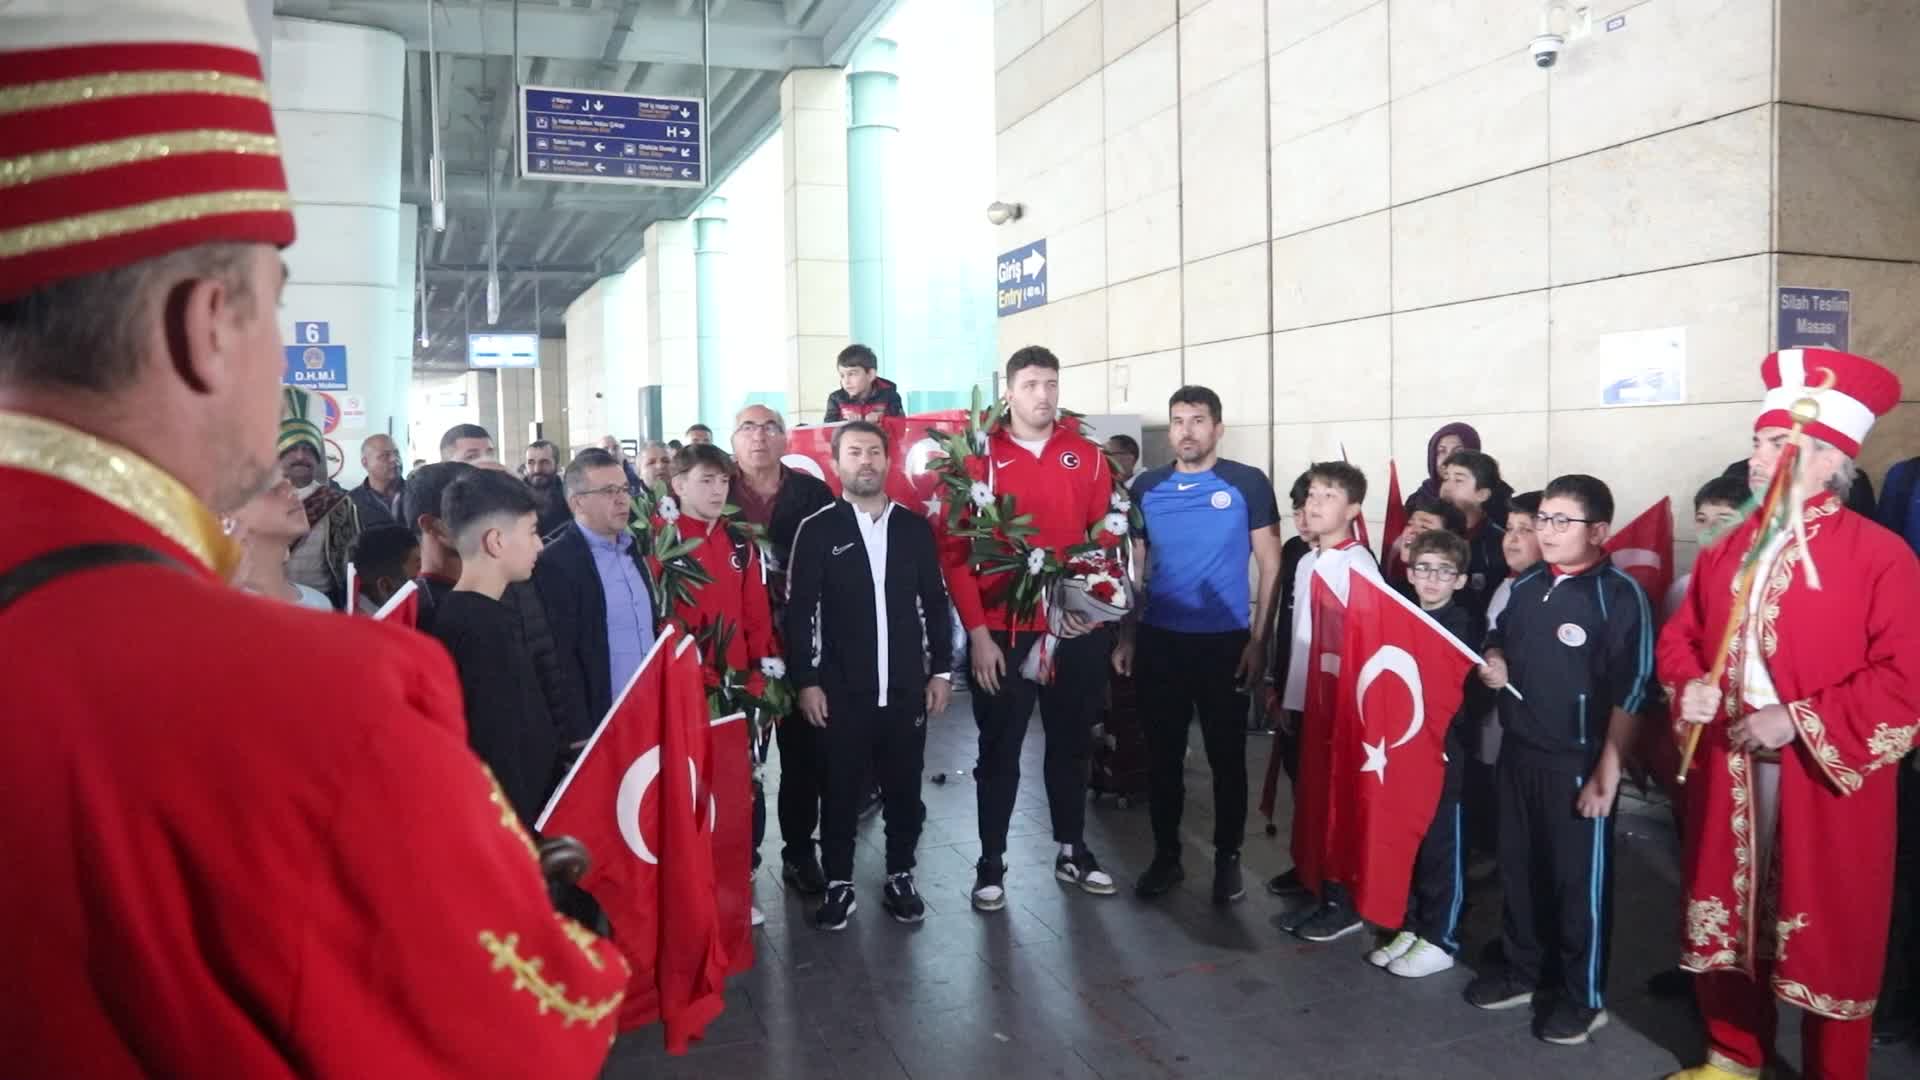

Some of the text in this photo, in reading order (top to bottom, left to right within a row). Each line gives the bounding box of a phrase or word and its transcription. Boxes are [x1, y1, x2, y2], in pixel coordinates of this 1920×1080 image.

[582, 99, 589, 111] J
[667, 126, 677, 138] H
[999, 259, 1022, 283] Giriş
[999, 288, 1023, 309] Entry
[1781, 294, 1849, 312] Silah Teslim
[306, 323, 320, 343] 6
